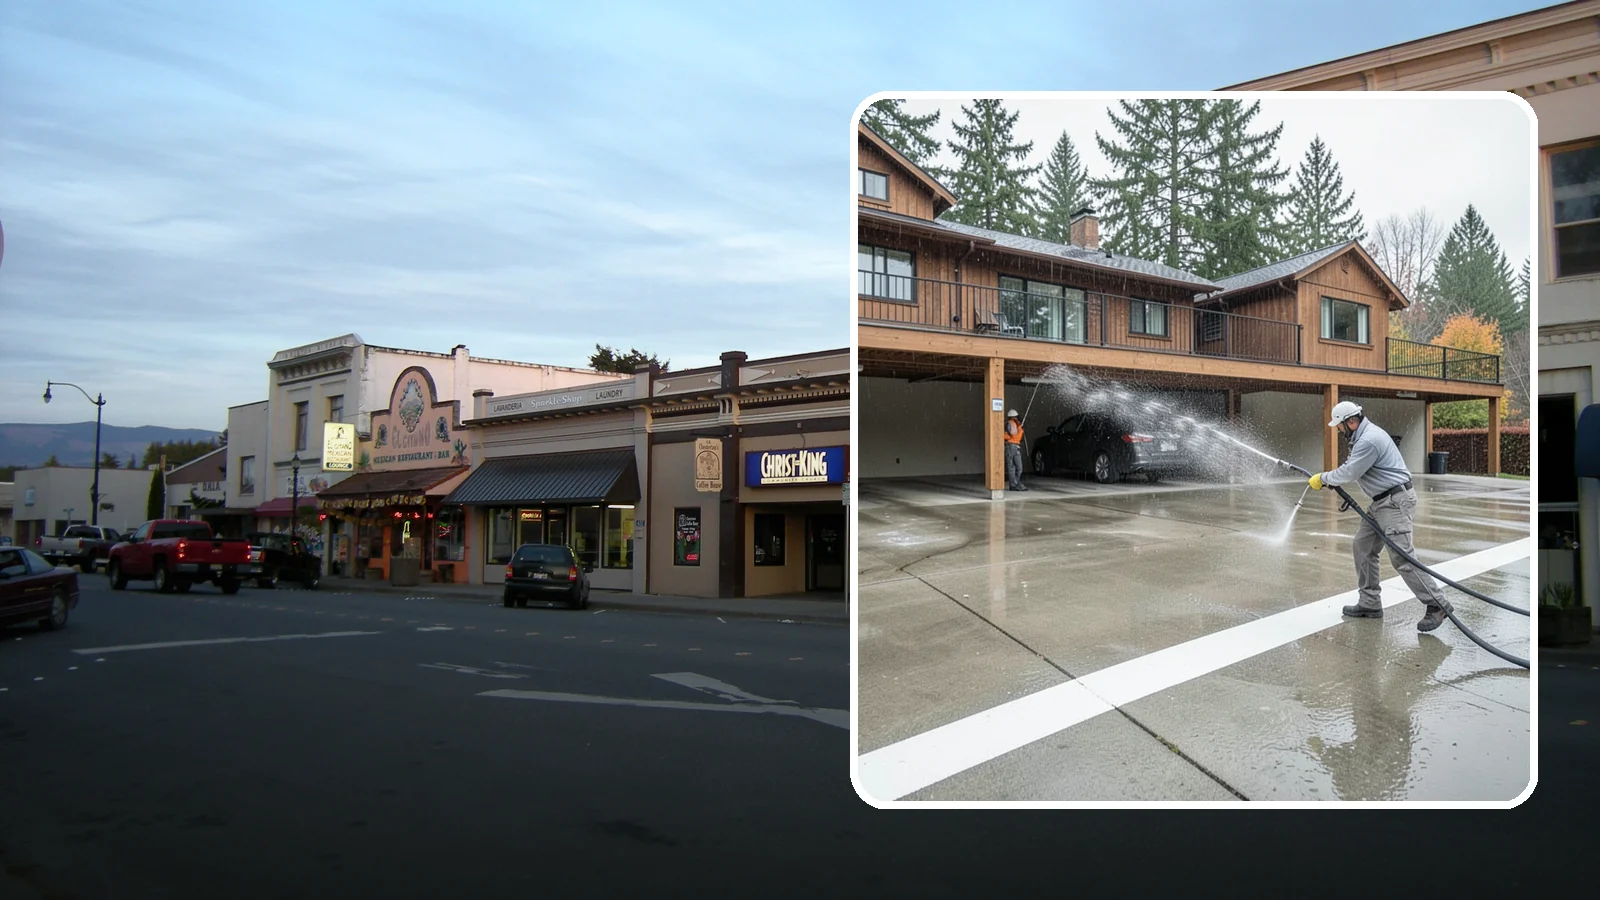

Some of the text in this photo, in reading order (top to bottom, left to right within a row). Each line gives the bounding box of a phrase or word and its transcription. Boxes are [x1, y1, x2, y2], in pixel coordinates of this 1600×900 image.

[562, 394, 582, 406] Shop
[595, 389, 624, 400] LAUNDRY
[493, 402, 523, 413] LAVANDERIA
[373, 449, 450, 464] MEXICAN RESTAURANT BAR
